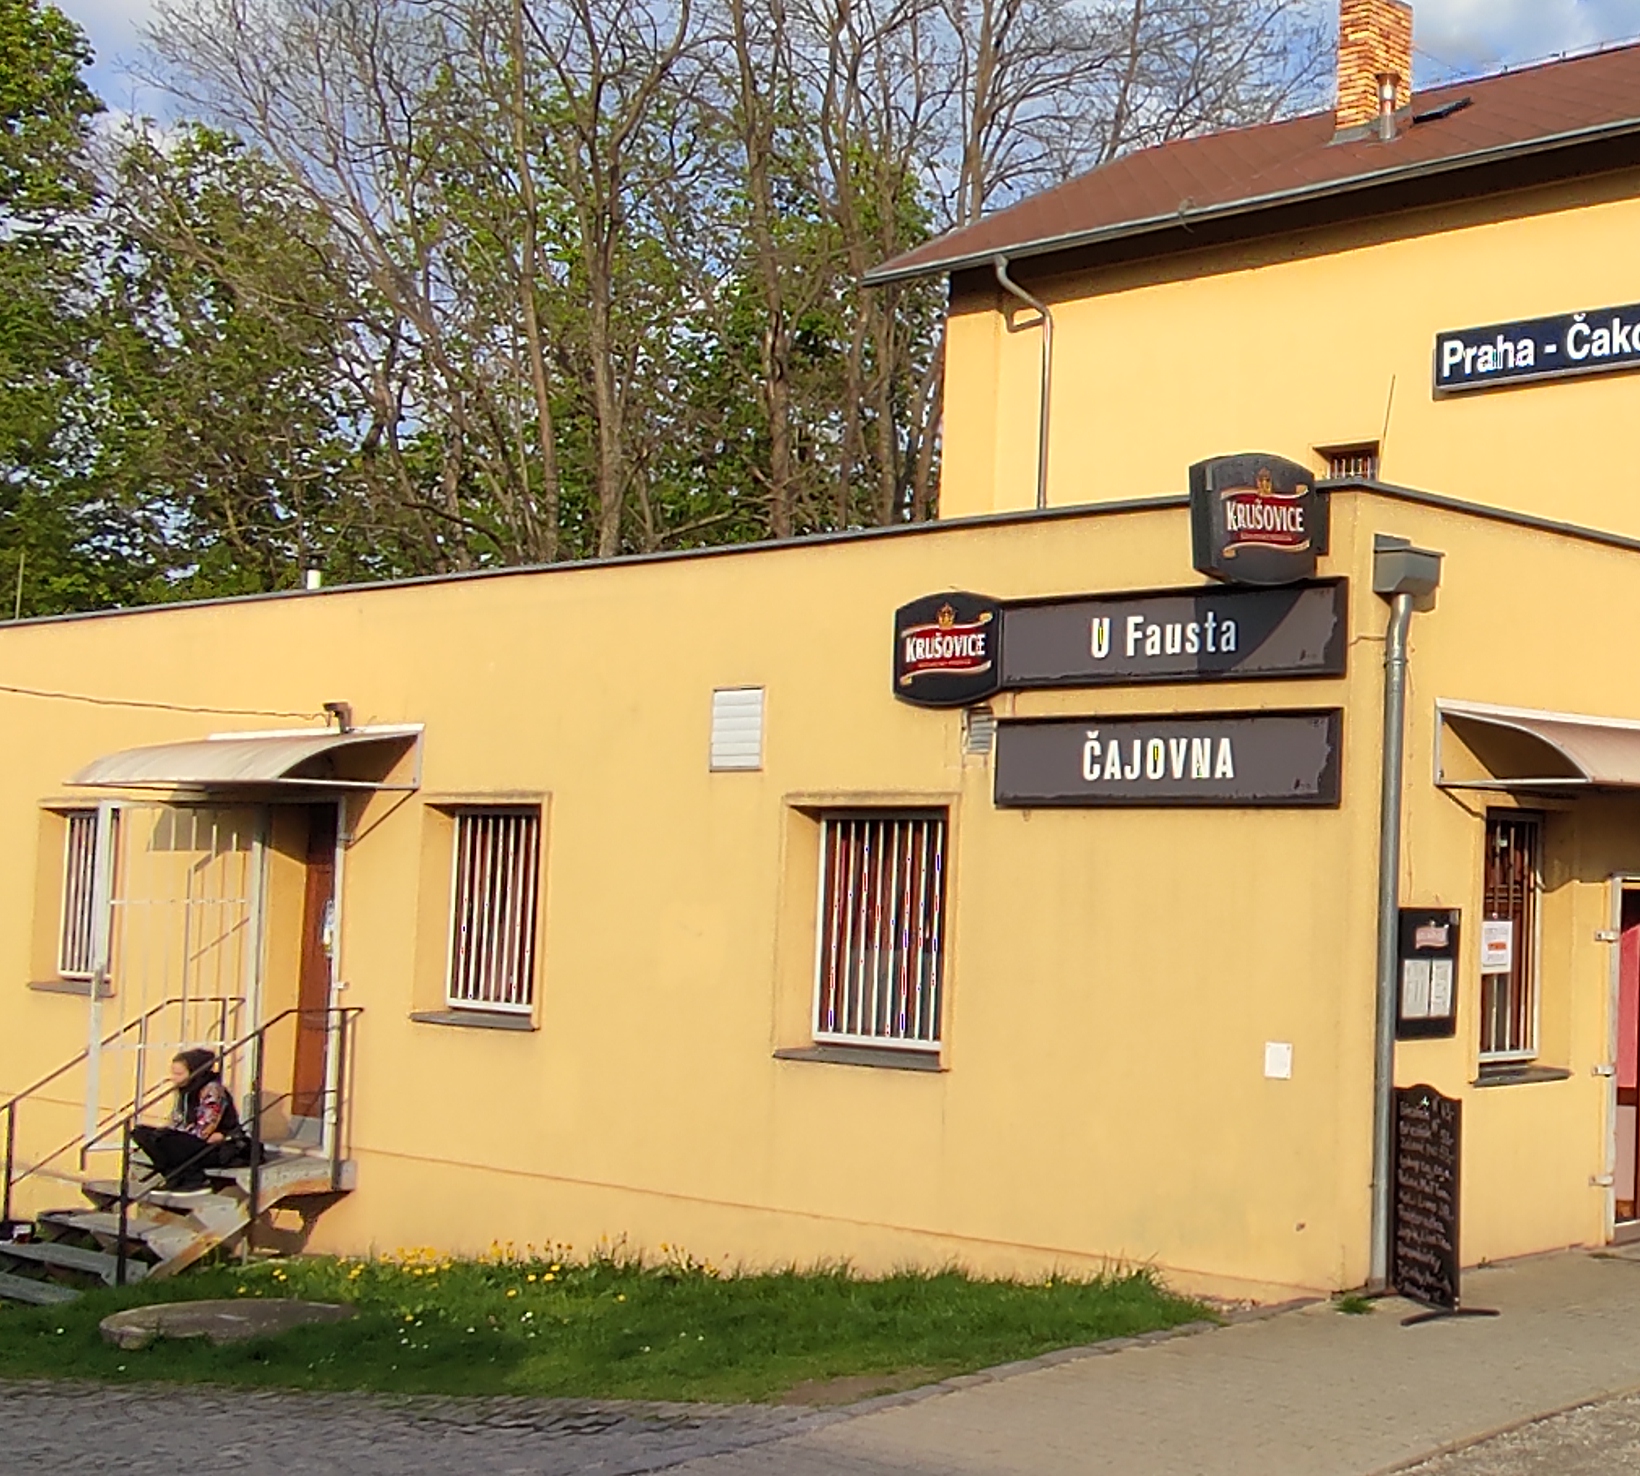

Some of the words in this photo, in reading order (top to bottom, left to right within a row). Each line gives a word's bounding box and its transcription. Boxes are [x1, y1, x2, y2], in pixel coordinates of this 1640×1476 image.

[1442, 335, 1535, 377] Praha
[1226, 498, 1305, 533] KRUŠOVICE
[905, 632, 986, 663] KRUŠOVICE
[1091, 617, 1111, 659] U
[1126, 611, 1237, 657] Fausta
[1082, 730, 1235, 781] ČAJOVNA
